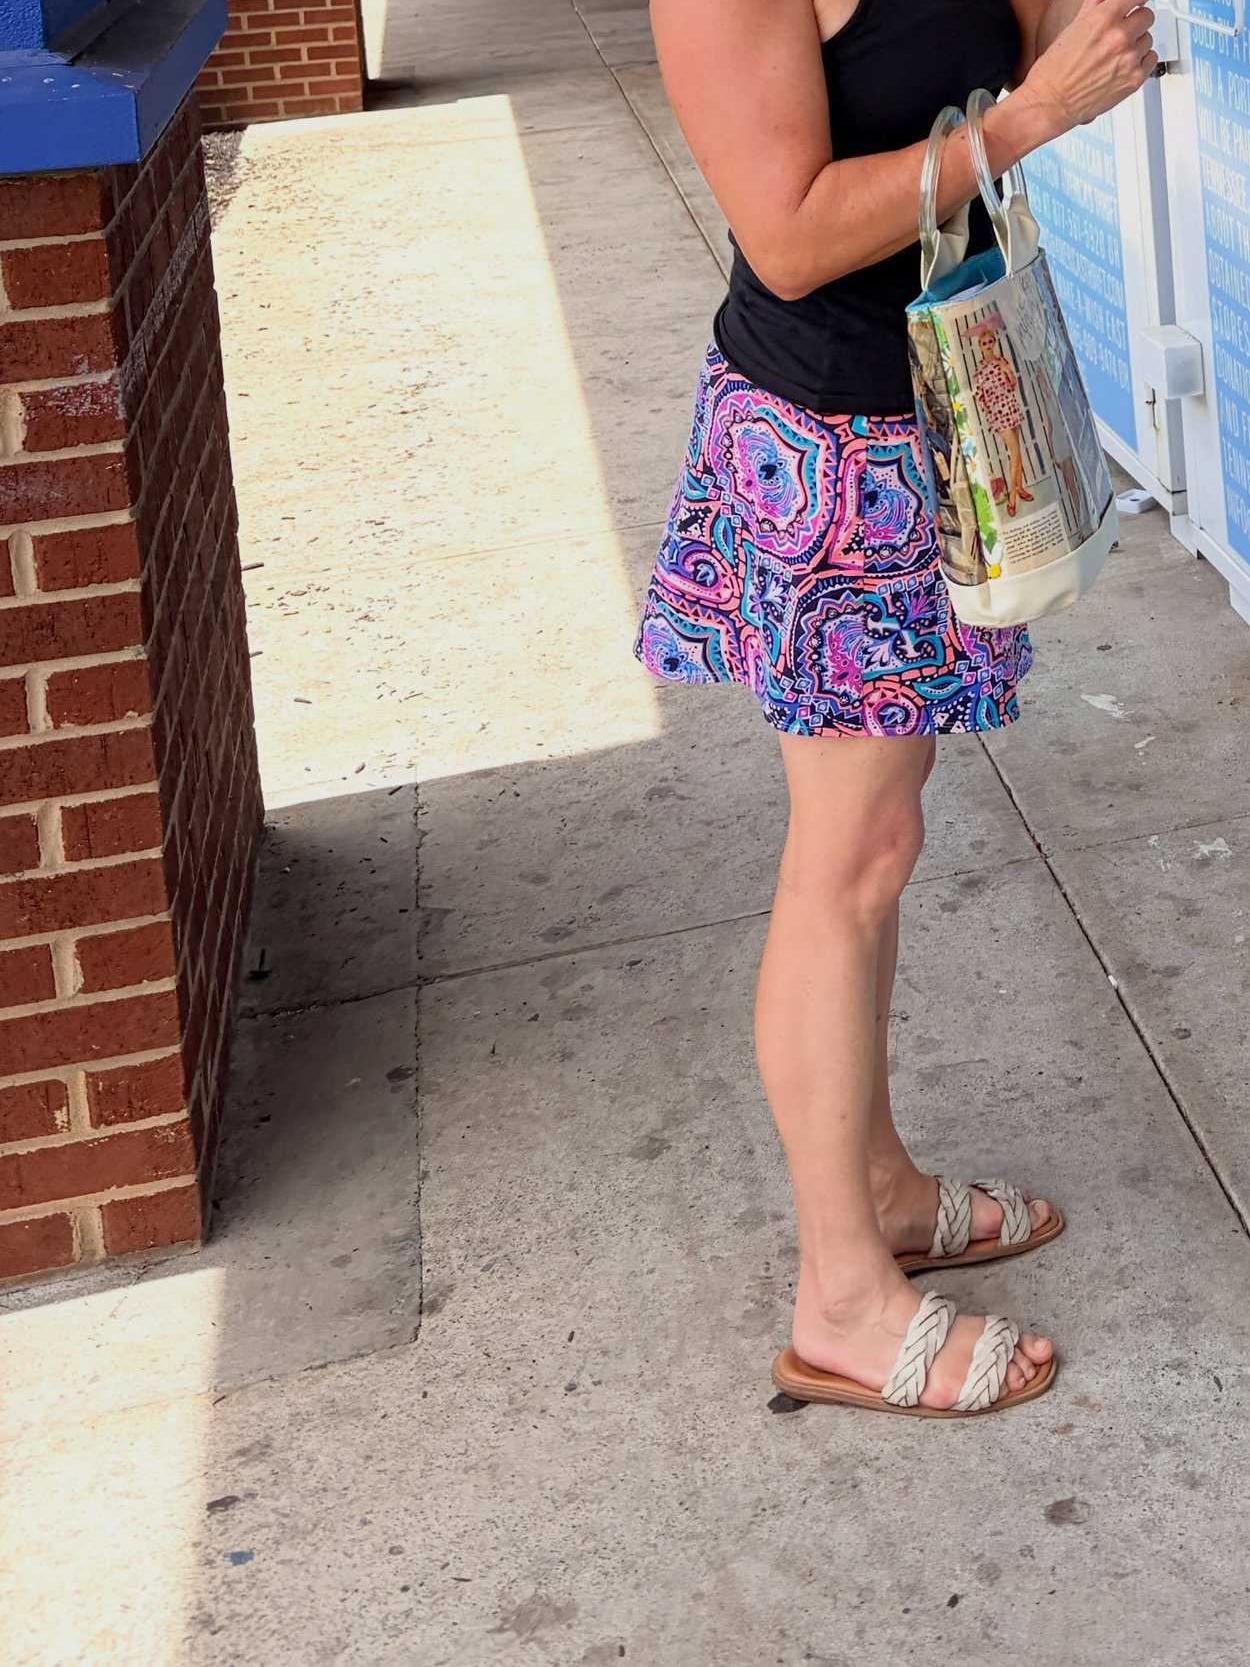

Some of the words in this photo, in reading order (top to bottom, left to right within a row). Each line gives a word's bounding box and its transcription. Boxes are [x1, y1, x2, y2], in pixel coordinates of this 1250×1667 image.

[1194, 55, 1212, 98] AND
[1216, 65, 1223, 103] A
[1198, 102, 1219, 149] WILL
[1219, 112, 1232, 156] BE
[1205, 198, 1234, 253] ABOUT
[1211, 293, 1250, 359] STORES
[1218, 387, 1239, 440] AND
